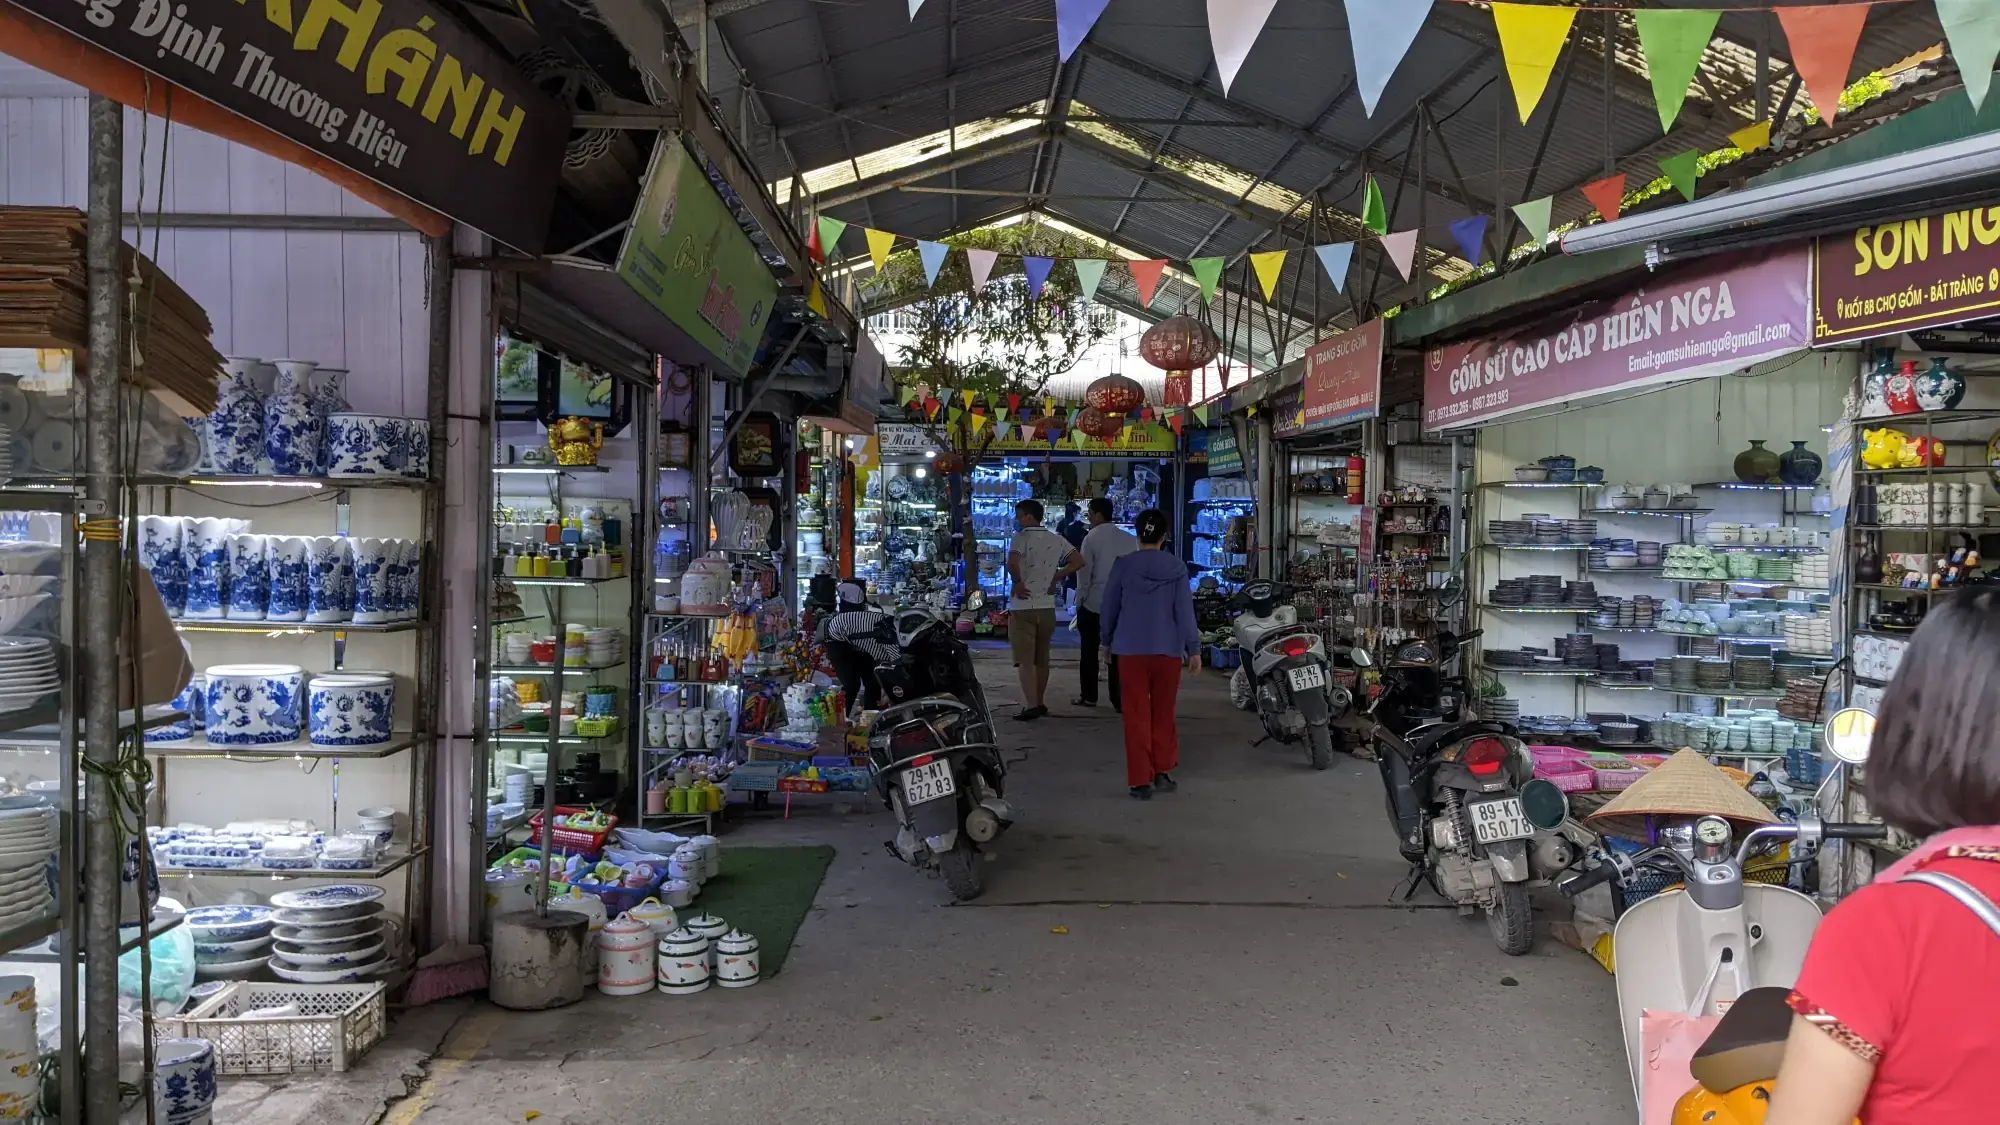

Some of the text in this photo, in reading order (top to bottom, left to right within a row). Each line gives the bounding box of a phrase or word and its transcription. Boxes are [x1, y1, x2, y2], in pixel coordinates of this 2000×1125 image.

[130, 0, 408, 168] Định Thương Hiệu
[1845, 295, 1863, 319] KIỐT
[1864, 301, 1875, 314] 8B
[1876, 292, 1897, 314] CHỢ
[1898, 284, 1922, 309] GỐM
[1930, 279, 1948, 302] BÁT
[1950, 273, 1984, 300] TRÀNG
[1449, 280, 1736, 395] GỐM SỨ CAO CẤP HIỀN NGA
[1628, 322, 1791, 373] Email:gomsuhiennga@gmail.com
[1315, 348, 1337, 366] TRANG
[1432, 350, 1441, 364] 32
[889, 433, 916, 446] Mai
[1292, 665, 1318, 680] 30-N2
[1295, 675, 1319, 690] 5717
[908, 763, 944, 786] 29-N1
[908, 777, 952, 802] 622.83
[1478, 799, 1521, 821] 89-K1
[1478, 817, 1532, 841] 050.78
